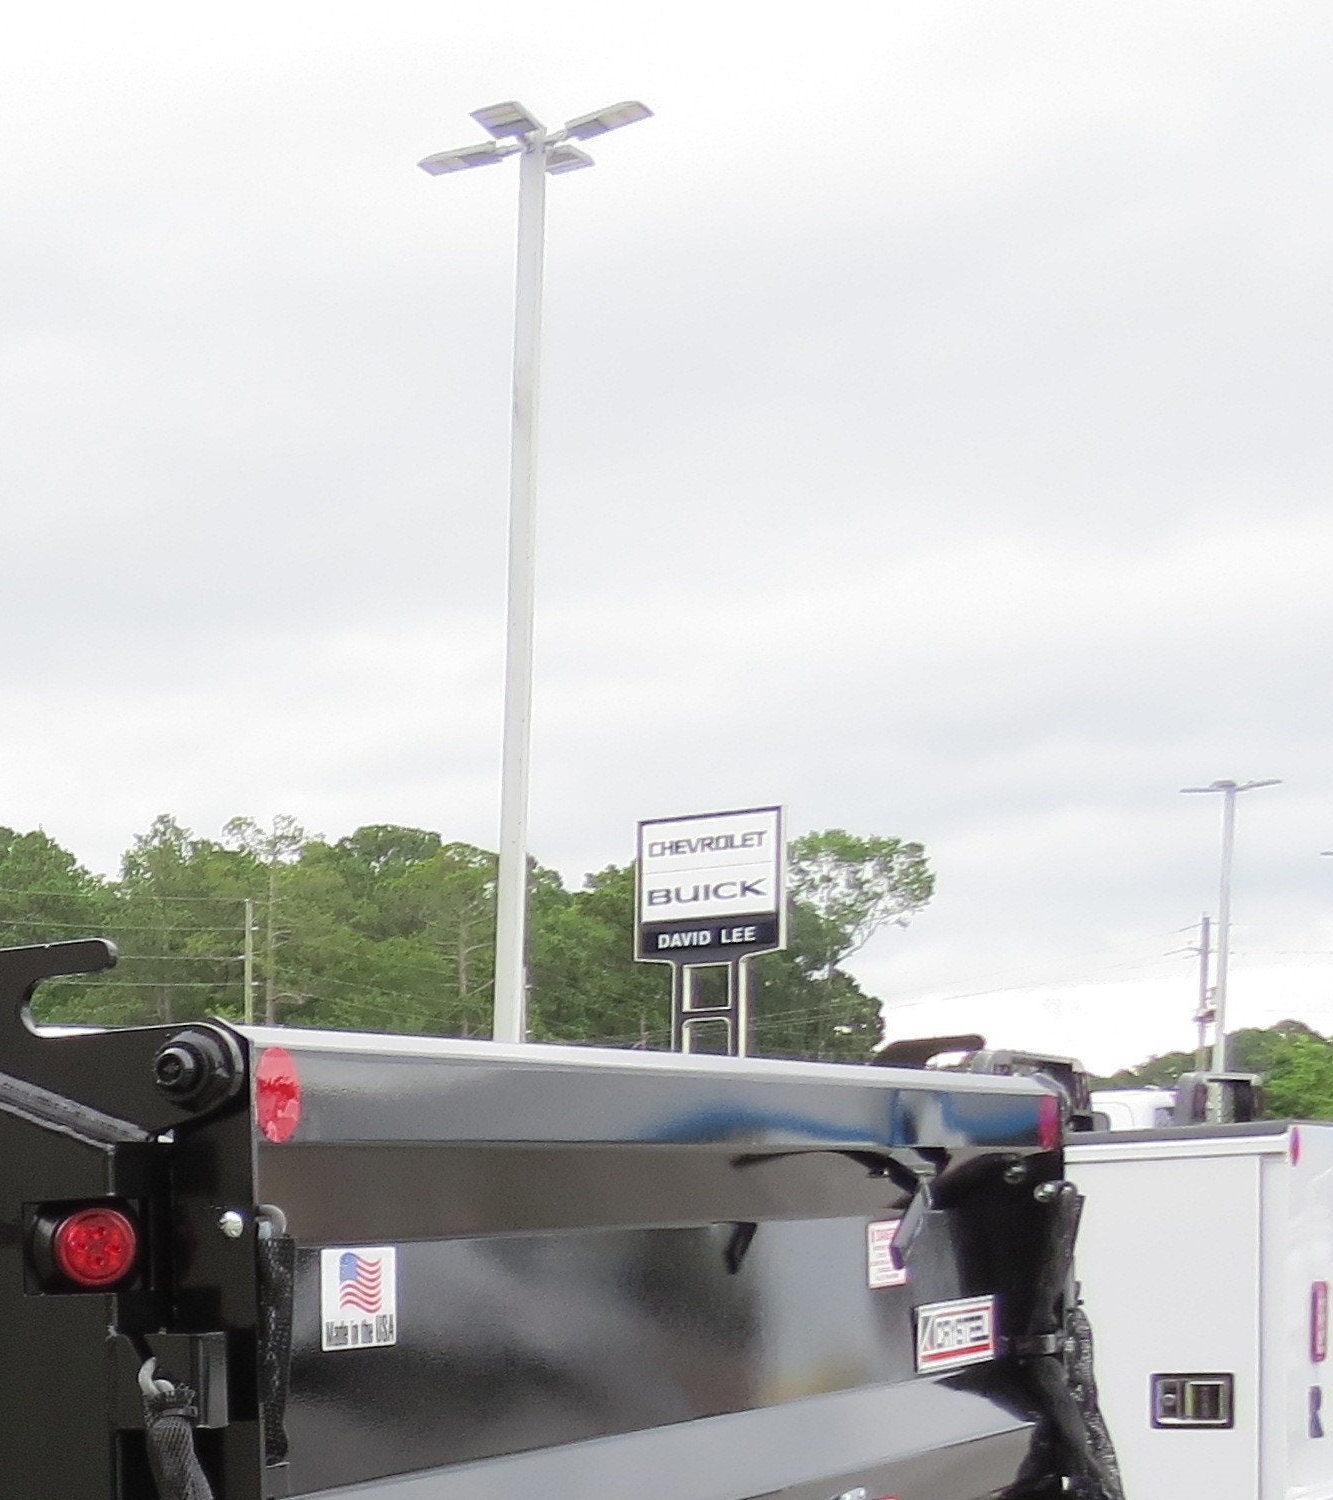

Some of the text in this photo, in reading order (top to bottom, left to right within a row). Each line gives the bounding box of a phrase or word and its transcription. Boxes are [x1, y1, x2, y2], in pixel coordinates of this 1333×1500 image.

[647, 830, 768, 858] CHEVROLET
[646, 877, 767, 907] BUICK
[657, 926, 757, 950] DAVID LEE
[375, 1313, 394, 1343] USA
[936, 1314, 991, 1350] CRYSTEEL
